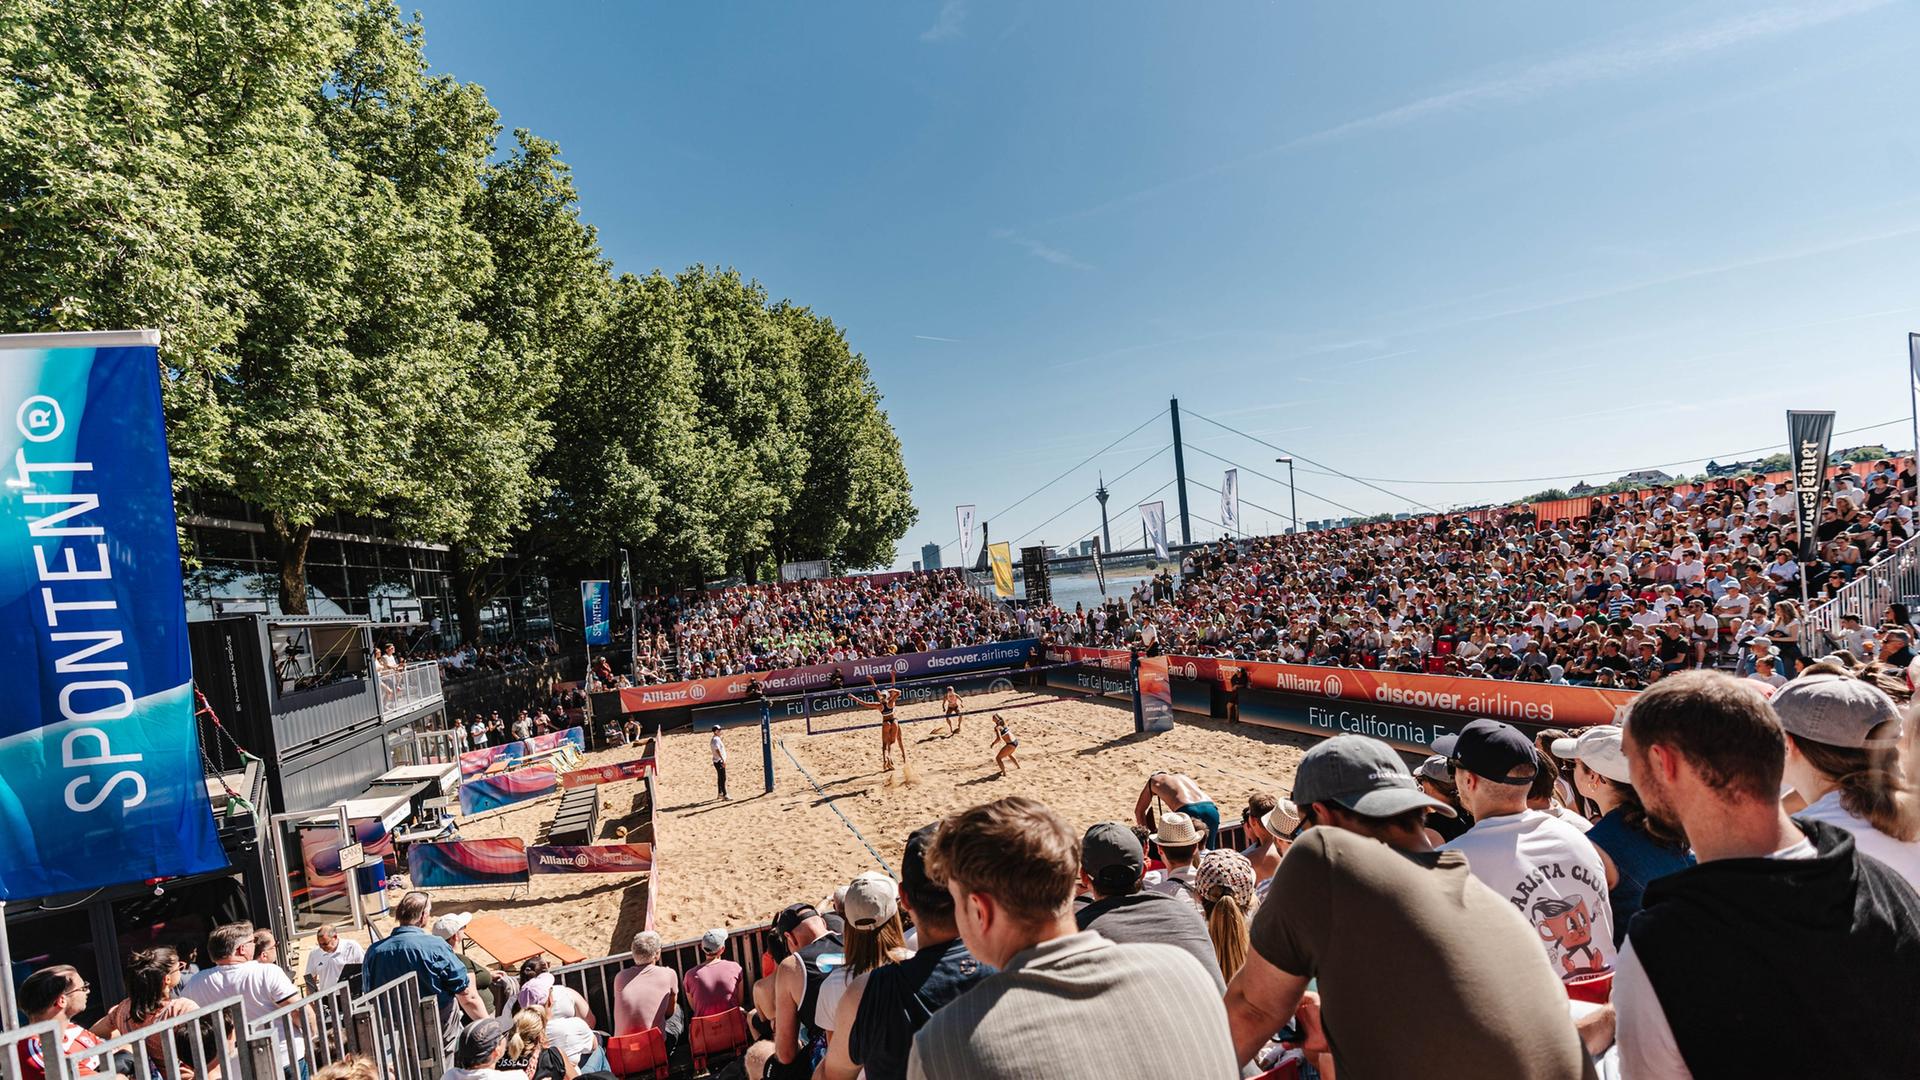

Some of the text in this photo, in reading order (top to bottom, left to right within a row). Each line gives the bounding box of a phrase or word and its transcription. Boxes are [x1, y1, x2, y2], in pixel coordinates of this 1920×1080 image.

[927, 648, 1020, 668] discover.airlines
[853, 663, 892, 677] Allianz
[727, 671, 832, 694] disver.airlines
[1276, 672, 1322, 693] Allianz
[642, 688, 688, 704] Allianz
[787, 702, 804, 716] Fü
[813, 692, 874, 713] Califoia
[1375, 682, 1554, 721] discover.airlines
[1308, 706, 1335, 728] Für
[1339, 711, 1426, 744] California
[539, 855, 574, 866] Allianz
